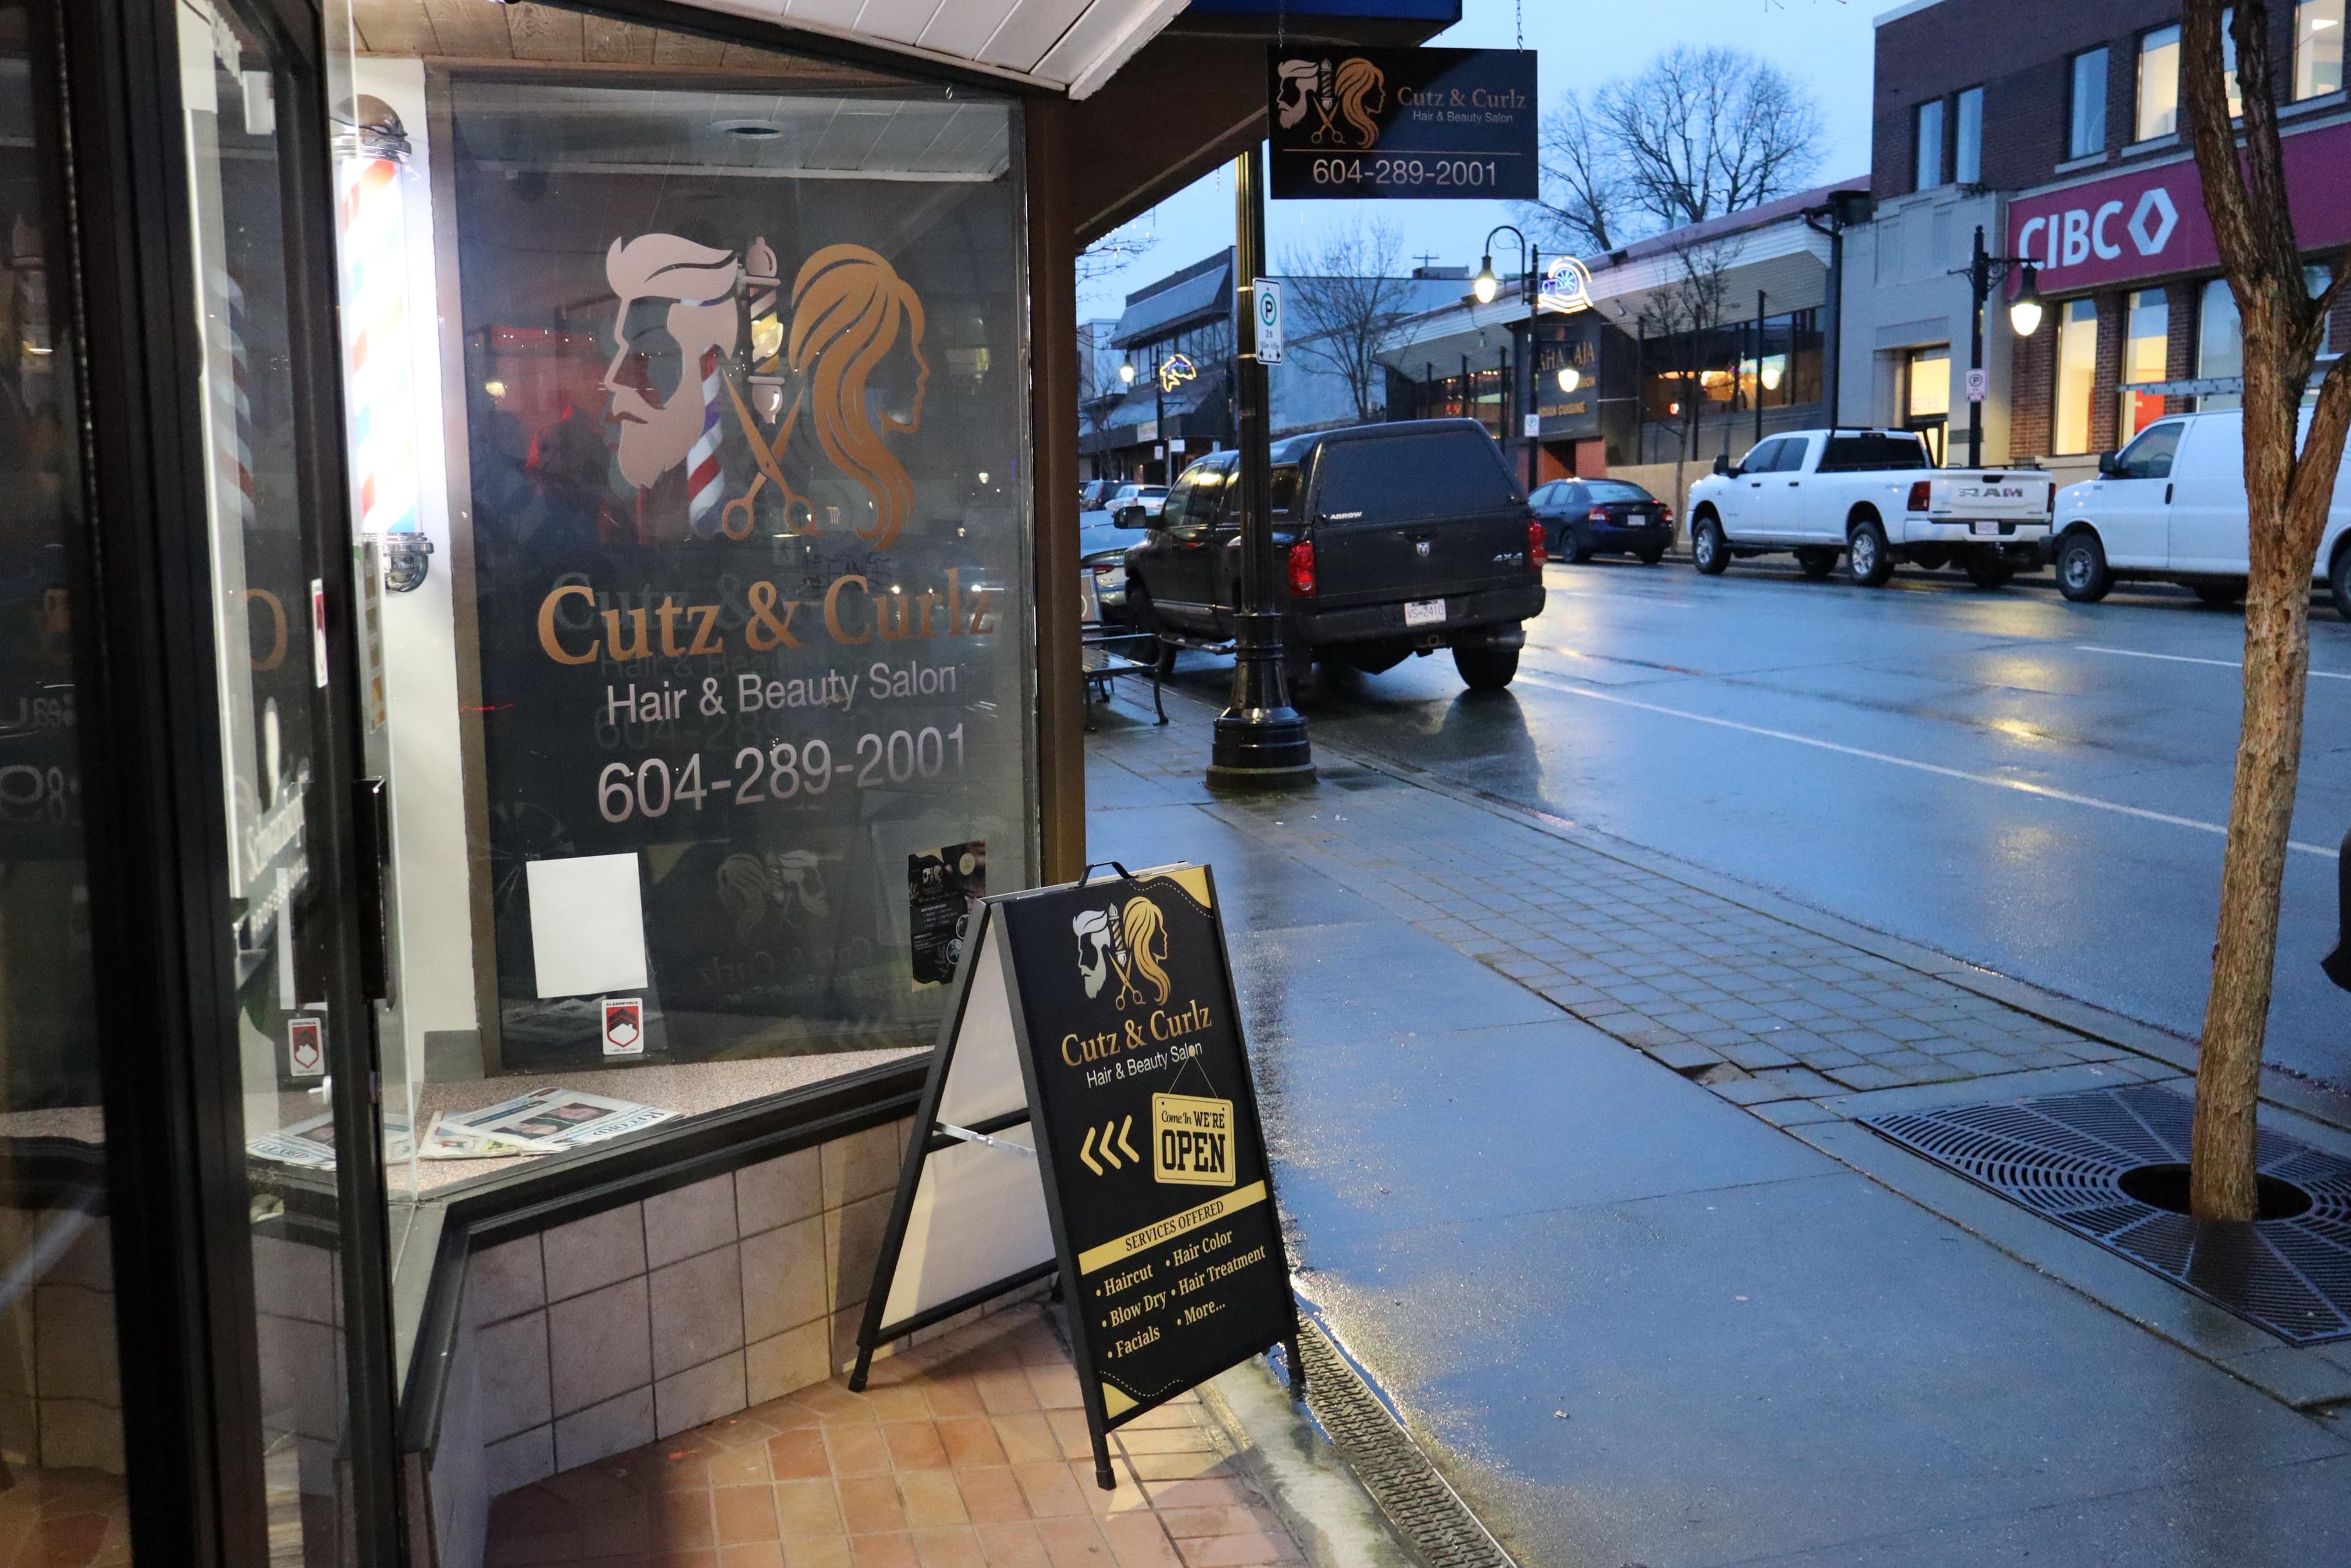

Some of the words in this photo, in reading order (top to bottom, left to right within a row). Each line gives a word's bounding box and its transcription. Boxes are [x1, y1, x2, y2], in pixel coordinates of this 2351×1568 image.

[1398, 87, 1444, 106] Cutz
[1450, 89, 1466, 107] &
[1472, 89, 1526, 108] Curlz
[1413, 111, 1434, 121] Hair
[1437, 112, 1444, 121] &
[1447, 111, 1482, 124] Beauty
[1485, 113, 1513, 122] Salon
[1313, 159, 1496, 186] 604-289-2001
[2019, 200, 2124, 271] CIBC
[1959, 488, 2023, 497] RAM
[1330, 511, 1362, 520] ARROW
[538, 584, 724, 665] Cutz
[746, 580, 808, 651] &
[824, 568, 995, 645] Curlz
[607, 681, 686, 725] Hair
[700, 678, 726, 716] &
[739, 669, 859, 713] Beauty
[870, 662, 956, 699] Salon
[598, 724, 964, 823] 604-289-2001
[1062, 1031, 1120, 1067] Cutz
[1125, 1019, 1147, 1049] &
[1150, 999, 1212, 1041] Curlz
[1087, 1067, 1112, 1088] Hair
[1116, 1063, 1125, 1079] &
[1127, 1052, 1168, 1076] Beauty
[1171, 1042, 1202, 1063] Salon
[1161, 1110, 1182, 1123] Come
[1183, 1112, 1192, 1124] In
[1193, 1111, 1224, 1128] WE'RE
[1162, 1130, 1225, 1173] OPEN
[1125, 1220, 1176, 1251] SERVICES
[1179, 1201, 1224, 1228] OFFERED
[1173, 1243, 1199, 1267] Hair
[1202, 1229, 1232, 1253] Color
[1104, 1263, 1153, 1297] Haircut
[1179, 1273, 1205, 1296] Hair
[1207, 1245, 1265, 1282] Treatment
[1110, 1302, 1141, 1327] Blow
[1144, 1290, 1166, 1310] Dry
[1116, 1325, 1160, 1358] Facials
